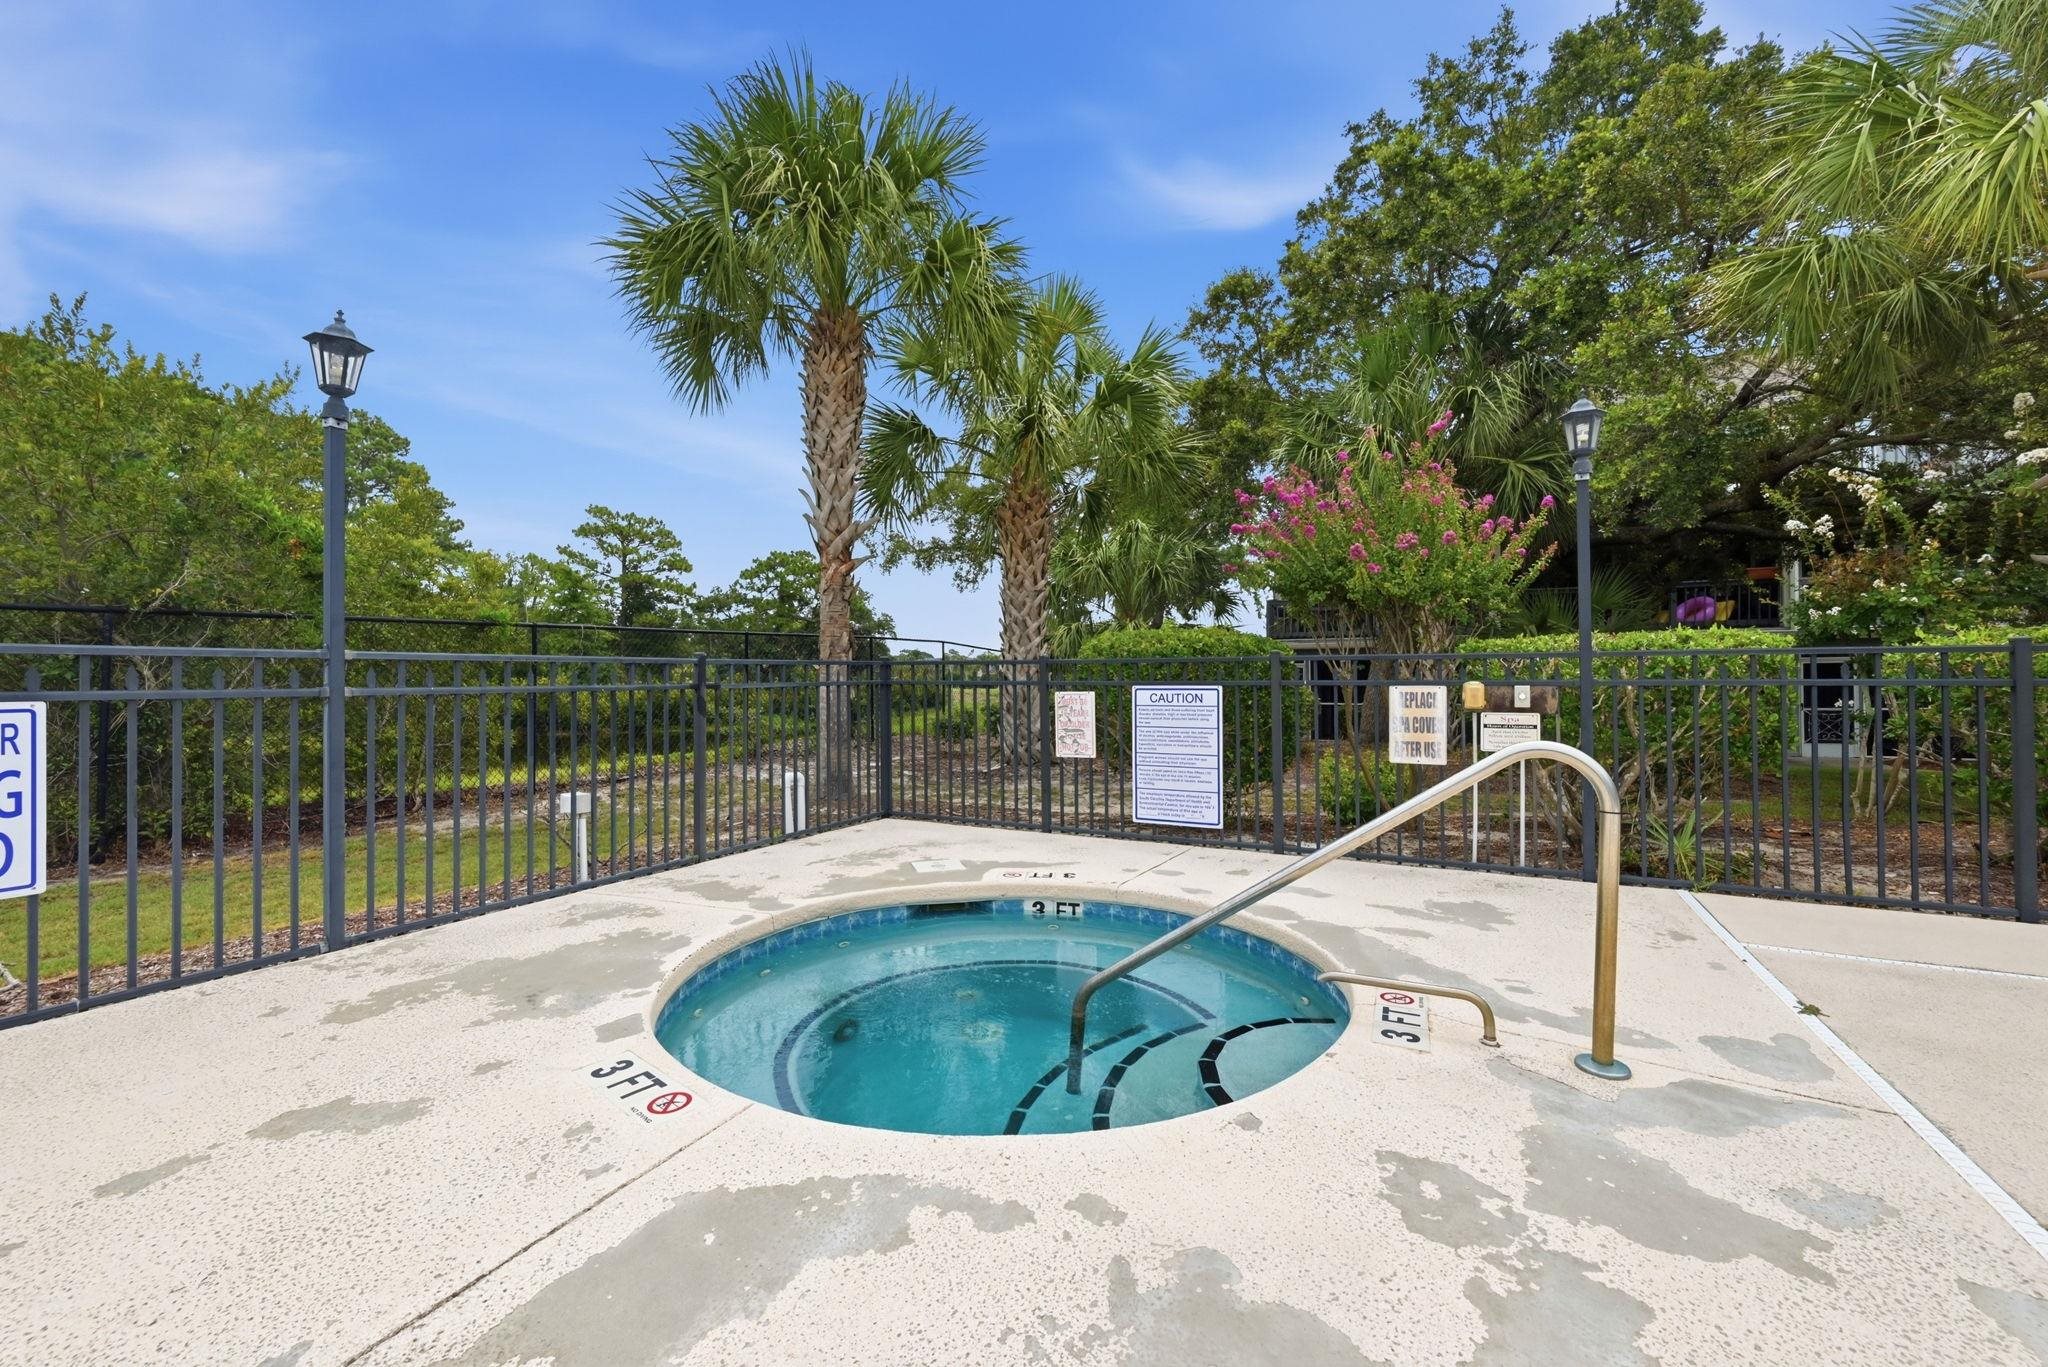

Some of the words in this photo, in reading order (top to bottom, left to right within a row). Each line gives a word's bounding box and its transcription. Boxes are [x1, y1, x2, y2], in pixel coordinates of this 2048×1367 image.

[1149, 692, 1203, 704] CAUTION
[1413, 715, 1441, 734] COVE
[1056, 901, 1080, 916] FT
[1381, 1006, 1421, 1027] FT
[1380, 1029, 1421, 1043] 3
[590, 1059, 635, 1079] 3
[606, 1070, 668, 1100] FT
